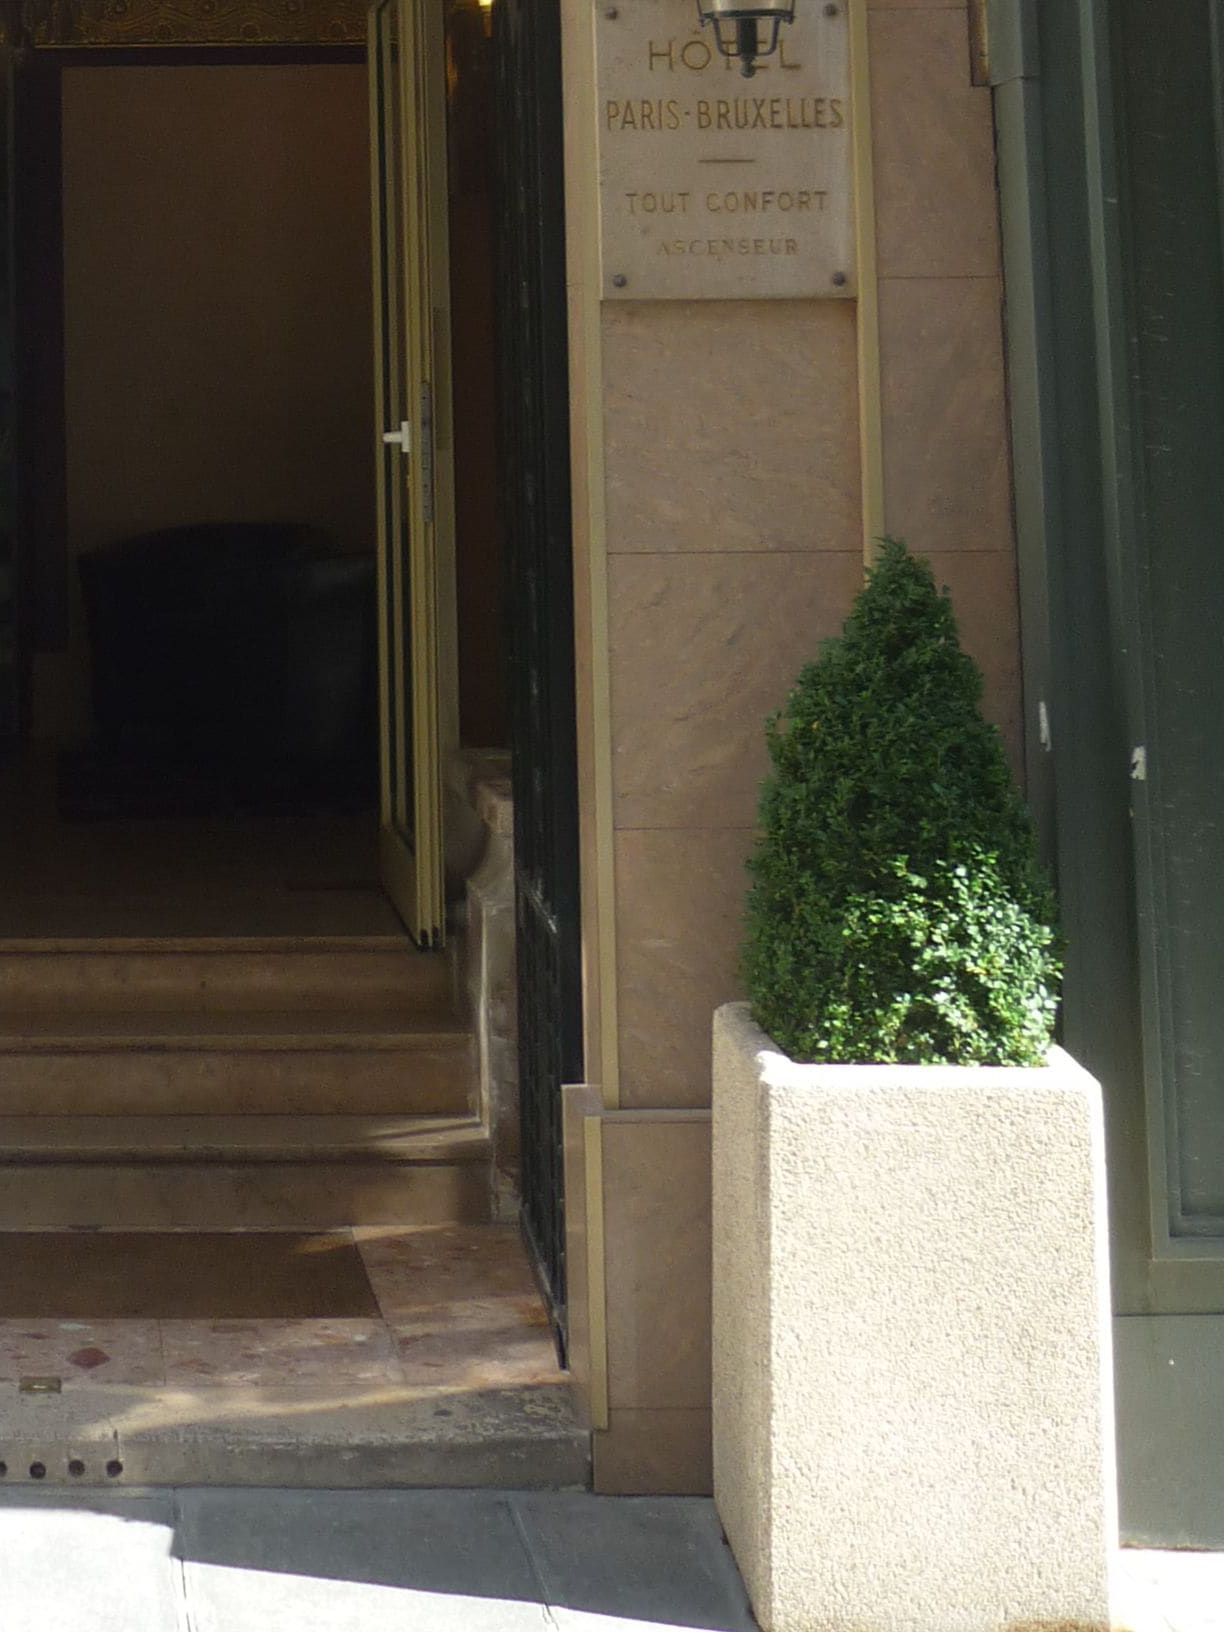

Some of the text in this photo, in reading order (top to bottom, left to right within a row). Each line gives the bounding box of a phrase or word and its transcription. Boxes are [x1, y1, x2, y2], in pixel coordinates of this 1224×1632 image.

[606, 97, 844, 131] PARIS-BRUXELLES
[625, 191, 828, 214] TOUT CONFORT
[656, 238, 798, 257] ASCENSEUR
